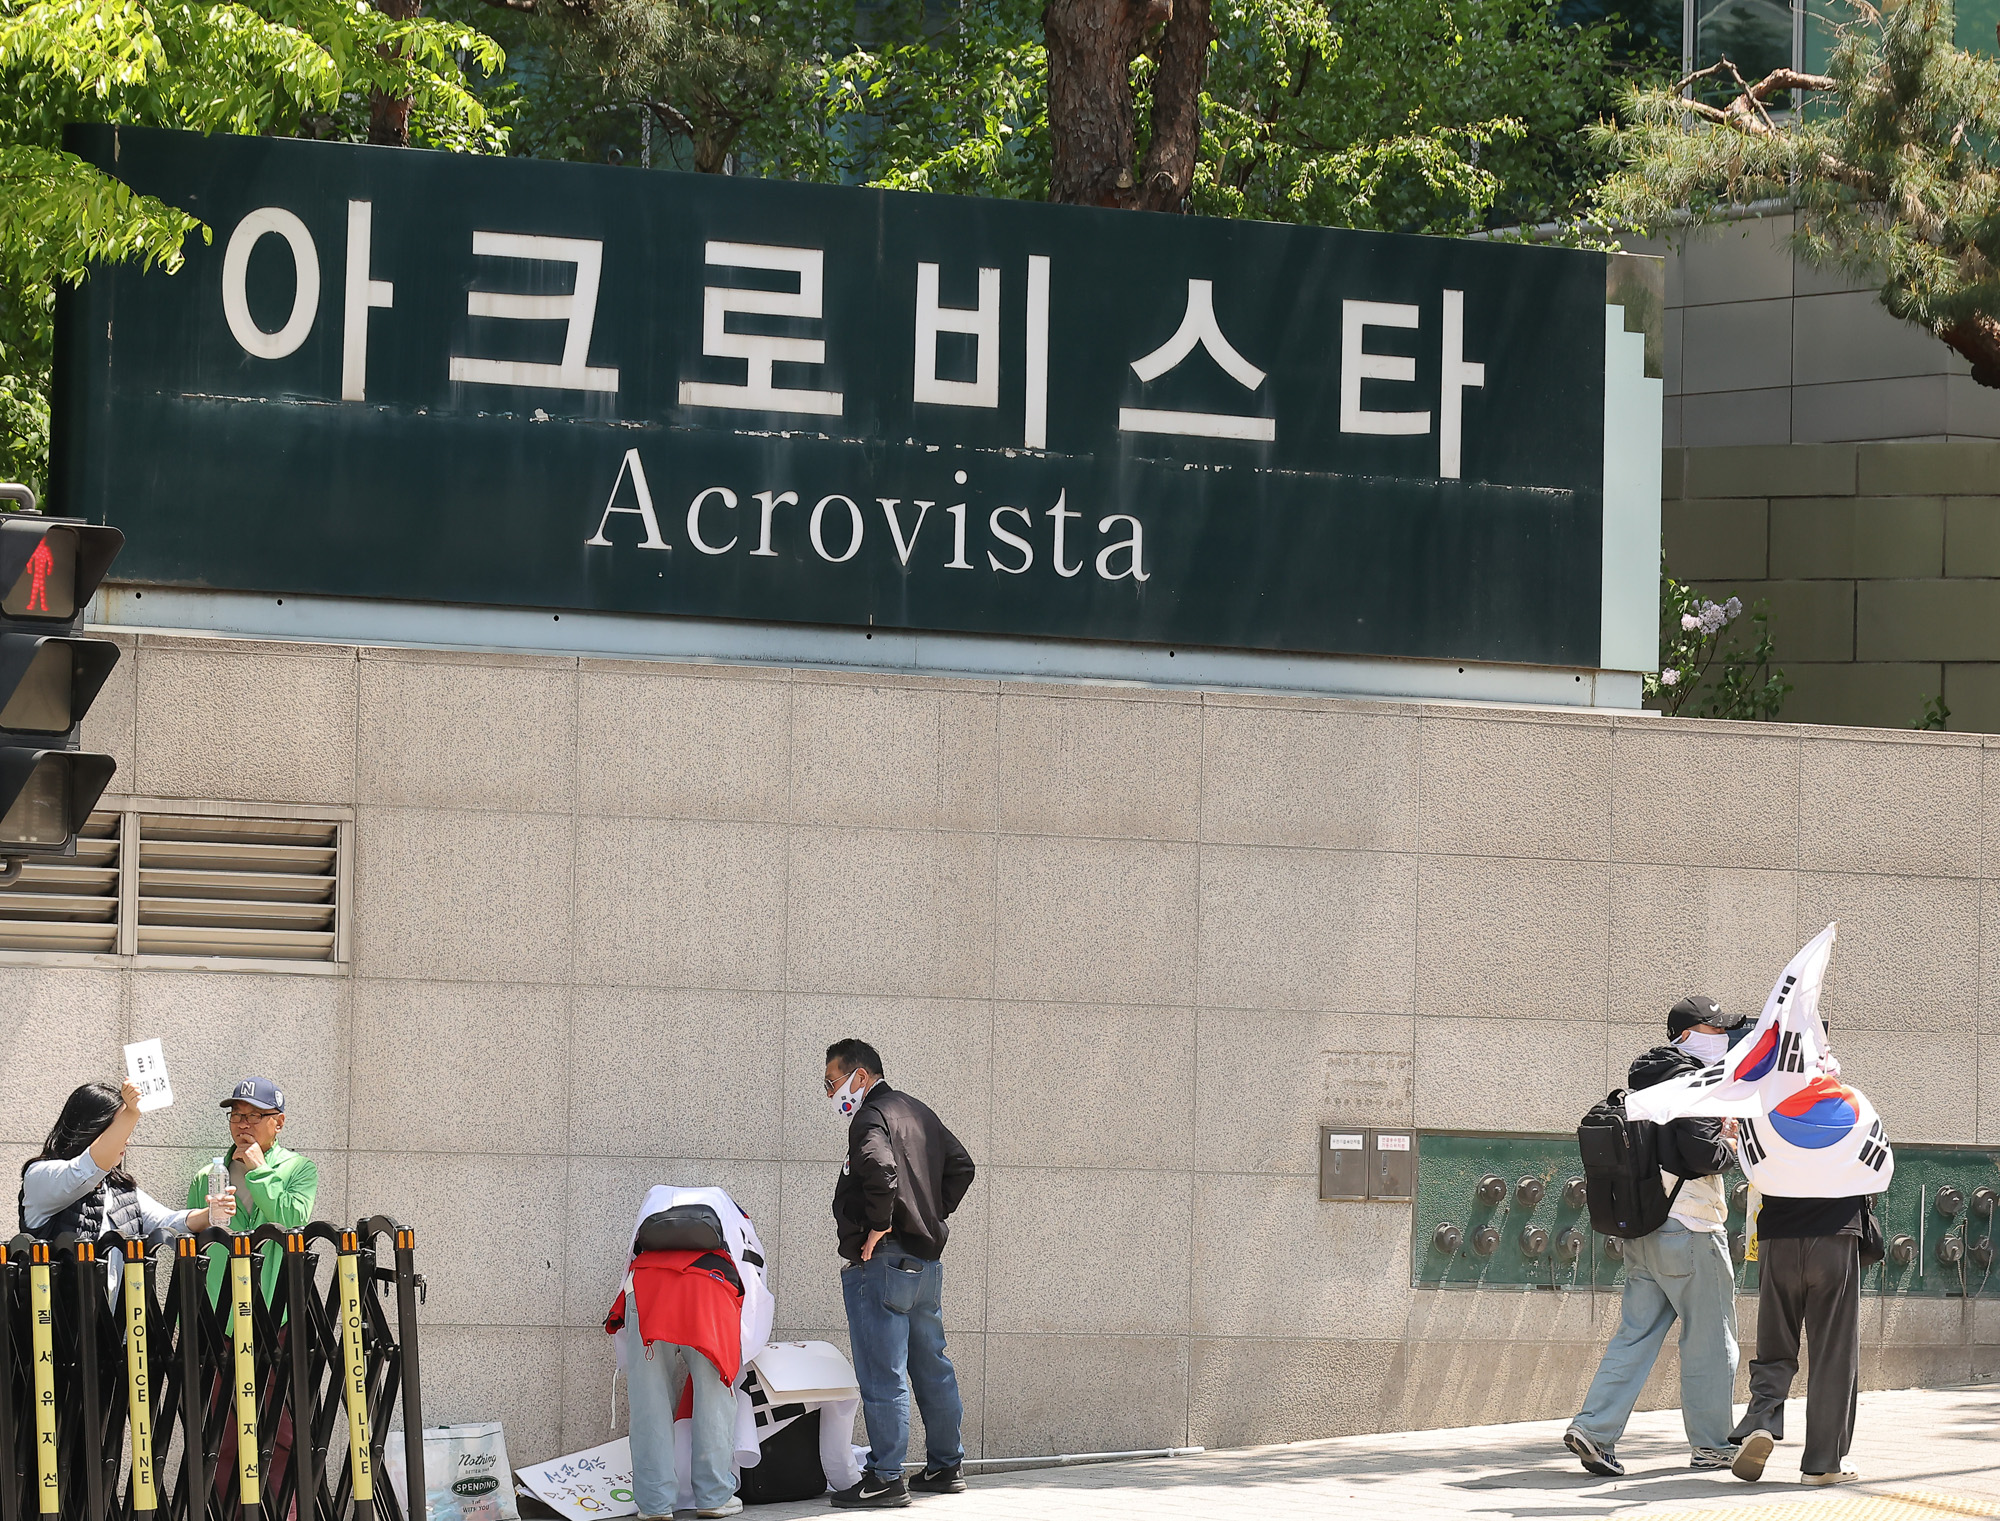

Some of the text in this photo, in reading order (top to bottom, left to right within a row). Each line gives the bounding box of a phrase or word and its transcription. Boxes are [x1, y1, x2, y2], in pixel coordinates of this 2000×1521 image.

[222, 199, 1485, 479] 아크로비스타
[585, 447, 1151, 583] Acrovista
[240, 1081, 256, 1097] N
[37, 1309, 58, 1488] 질서유지선
[133, 1307, 150, 1485] POLICE LINE
[238, 1301, 259, 1479] 질서유지선
[349, 1298, 369, 1475] POLICE LINE
[457, 1452, 497, 1468] Nothing
[456, 1480, 496, 1492] SPENDING
